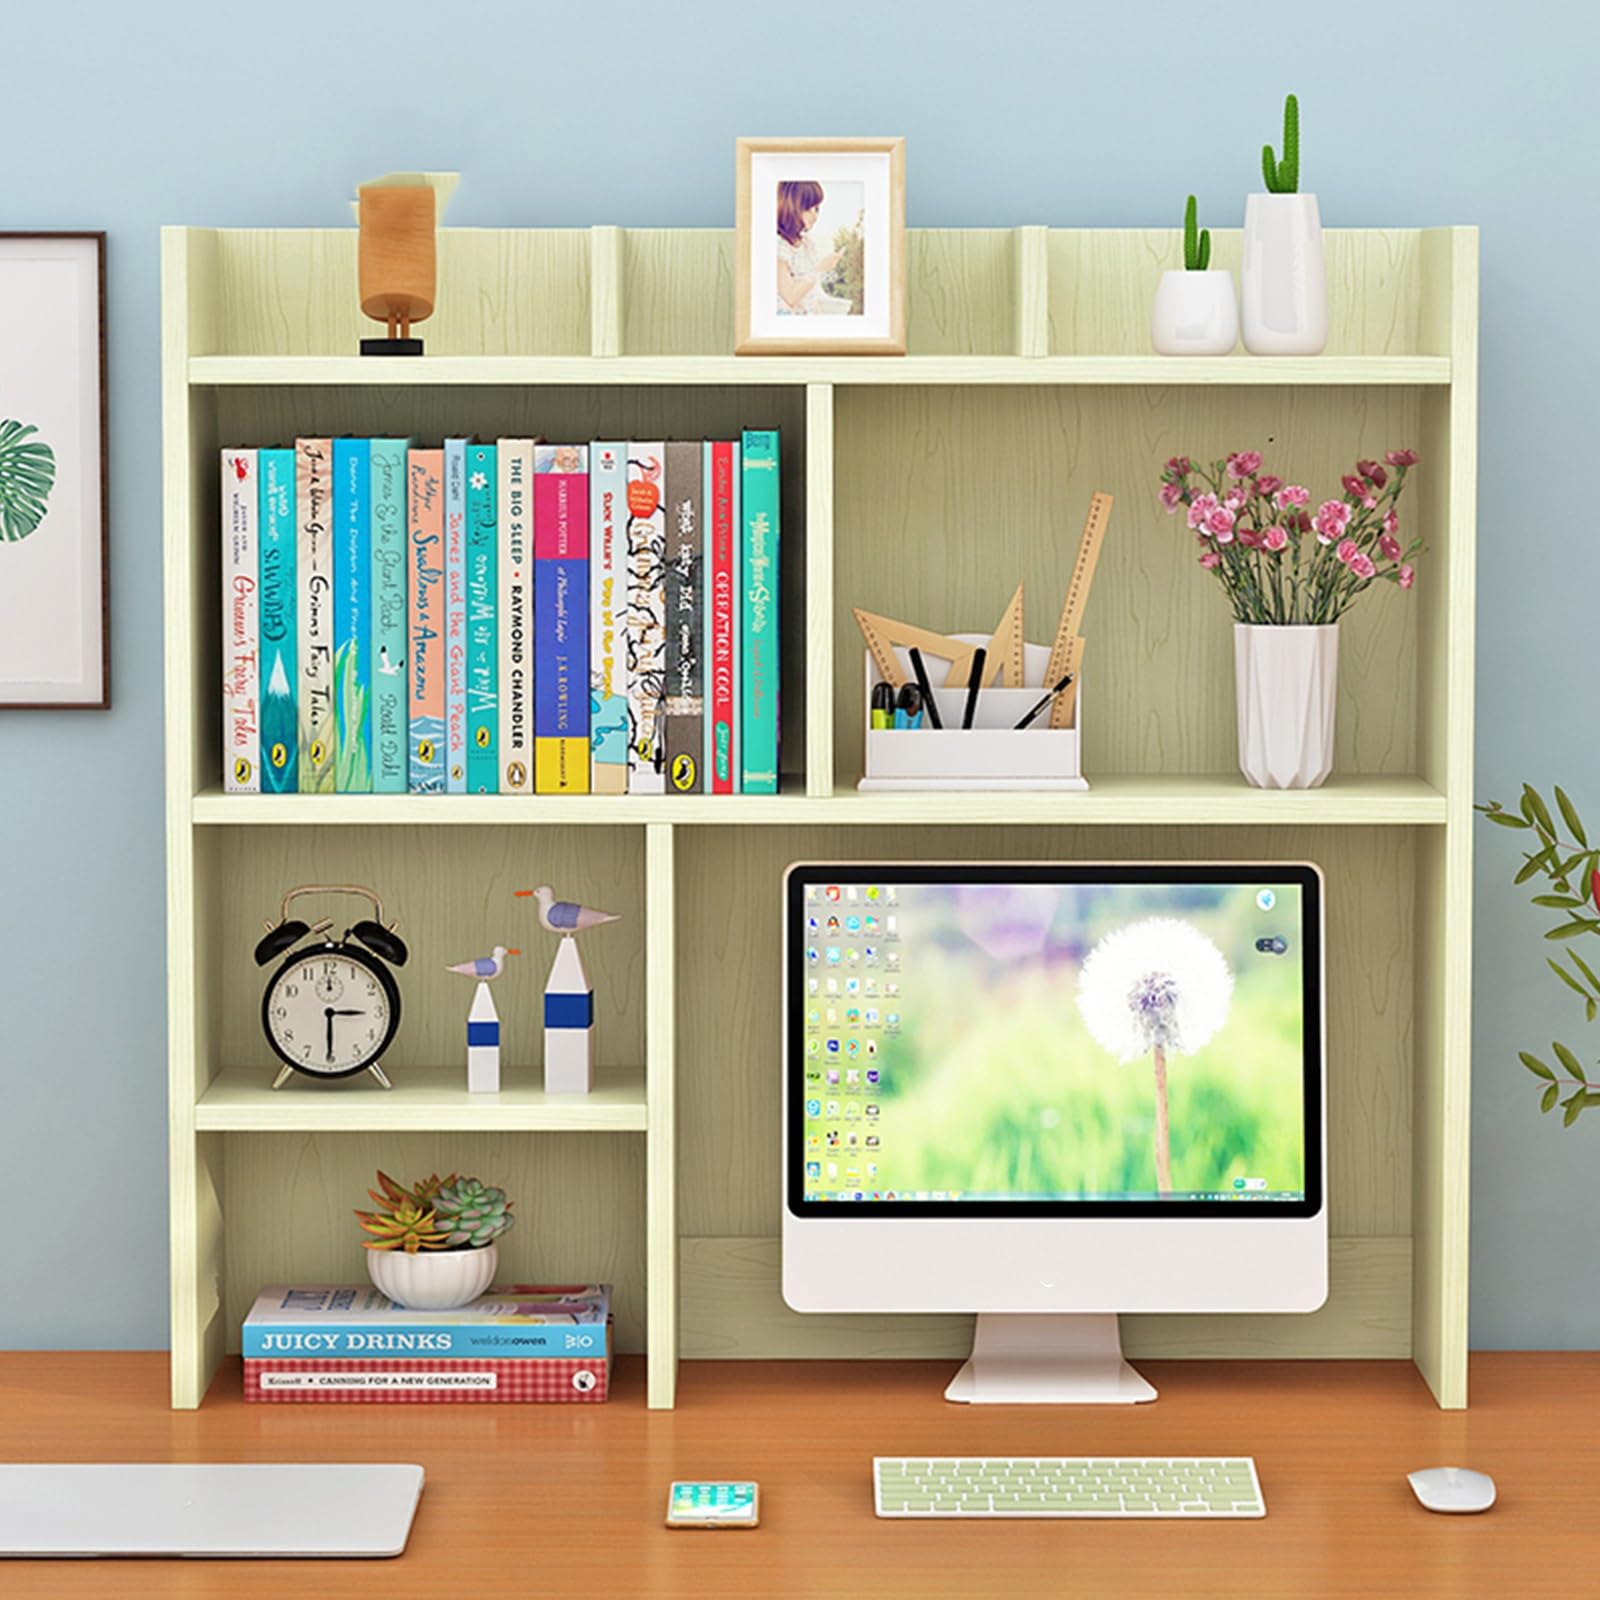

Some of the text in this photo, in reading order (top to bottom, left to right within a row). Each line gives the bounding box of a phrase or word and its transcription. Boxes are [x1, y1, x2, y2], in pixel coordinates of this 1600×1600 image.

[558, 521, 567, 555] POTTER
[413, 530, 443, 609] Swallows
[511, 457, 523, 750] THE BIG SLEEP RAYMOND CHANDLER
[380, 593, 404, 635] Peach
[715, 571, 730, 662] OPERATION
[449, 512, 465, 752] James and the Giant Peach
[306, 645, 330, 677] Fairy
[224, 649, 256, 699] Fairy
[716, 667, 730, 707] COOL
[310, 685, 330, 726] Tales
[230, 699, 257, 747] Tales
[380, 694, 401, 781] Roald Dahl
[302, 967, 314, 981] 11
[323, 961, 337, 975] 12
[351, 966, 356, 980] 1
[285, 984, 299, 997] 10
[366, 983, 377, 996] 2
[276, 1008, 287, 1021] 9
[374, 1006, 383, 1019] 3
[284, 1029, 294, 1042] 8
[366, 1028, 375, 1041] 4
[303, 1044, 312, 1059] 7
[353, 1044, 361, 1057] 5
[261, 1333, 452, 1350] JUICY DRINKS
[319, 1377, 366, 1385] CANNING
[368, 1377, 388, 1385] FOR
[391, 1377, 400, 1385] A
[401, 1377, 424, 1385] NEW
[426, 1377, 491, 1385] GENERATION
